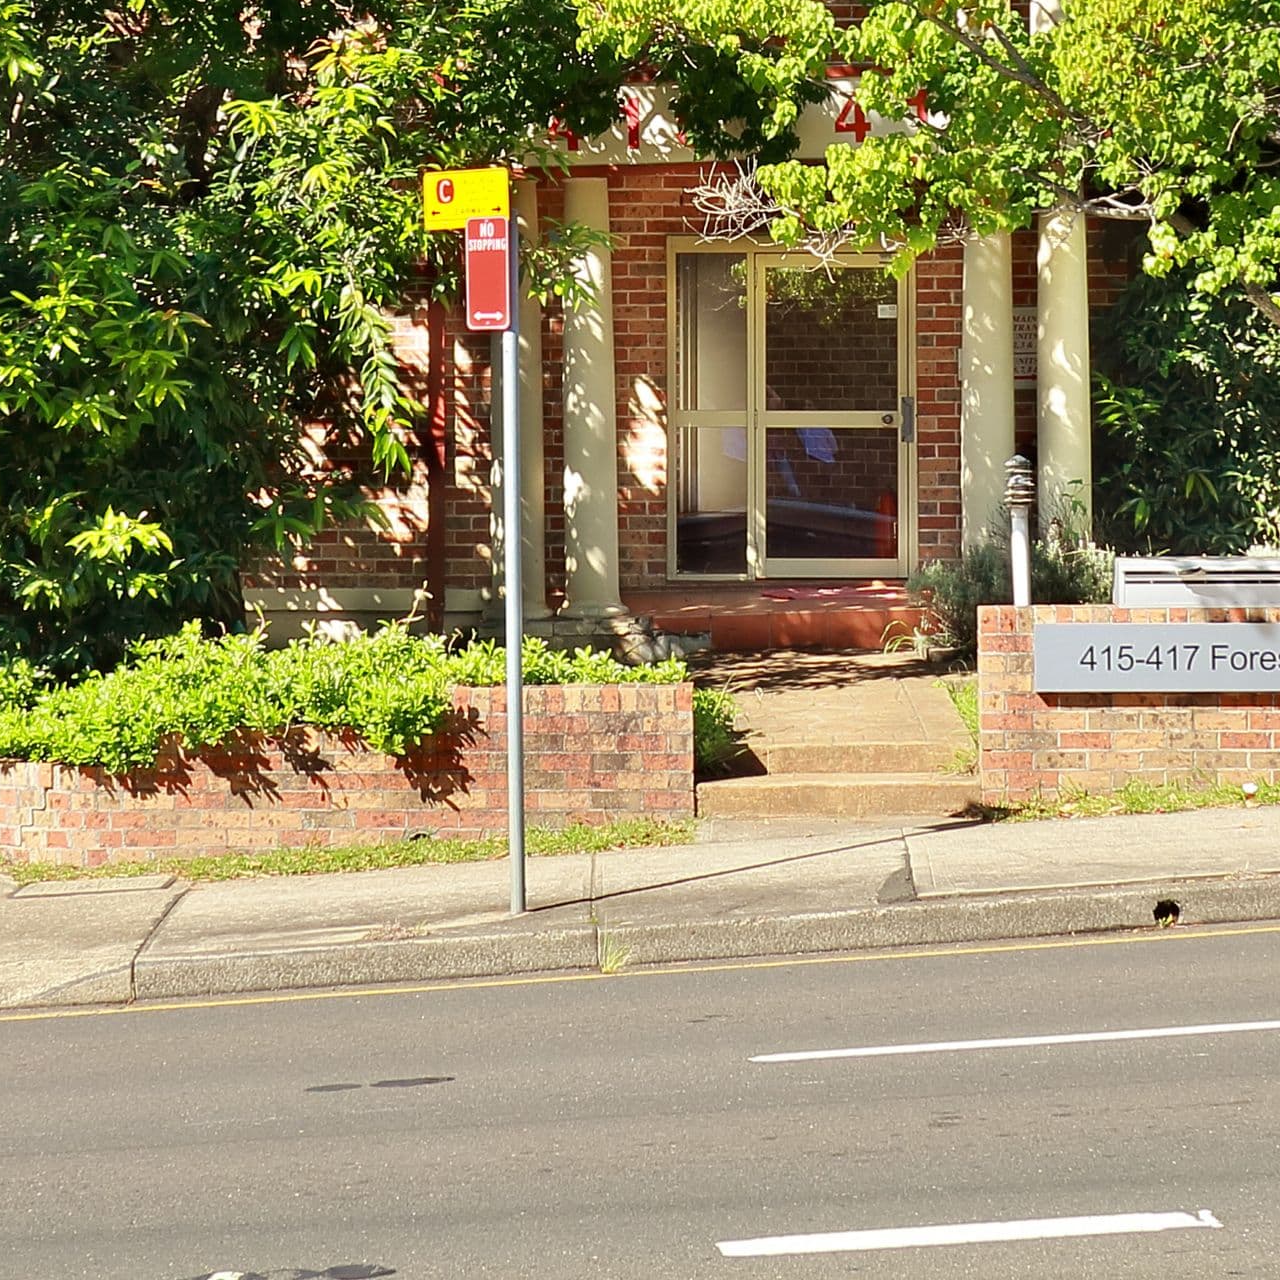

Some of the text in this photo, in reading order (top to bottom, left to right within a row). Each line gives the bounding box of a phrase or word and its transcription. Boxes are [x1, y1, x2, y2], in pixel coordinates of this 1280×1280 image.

[439, 179, 452, 203] C
[479, 222, 495, 238] NO
[468, 238, 507, 252] STOPPING
[1079, 644, 1200, 671] 415-417
